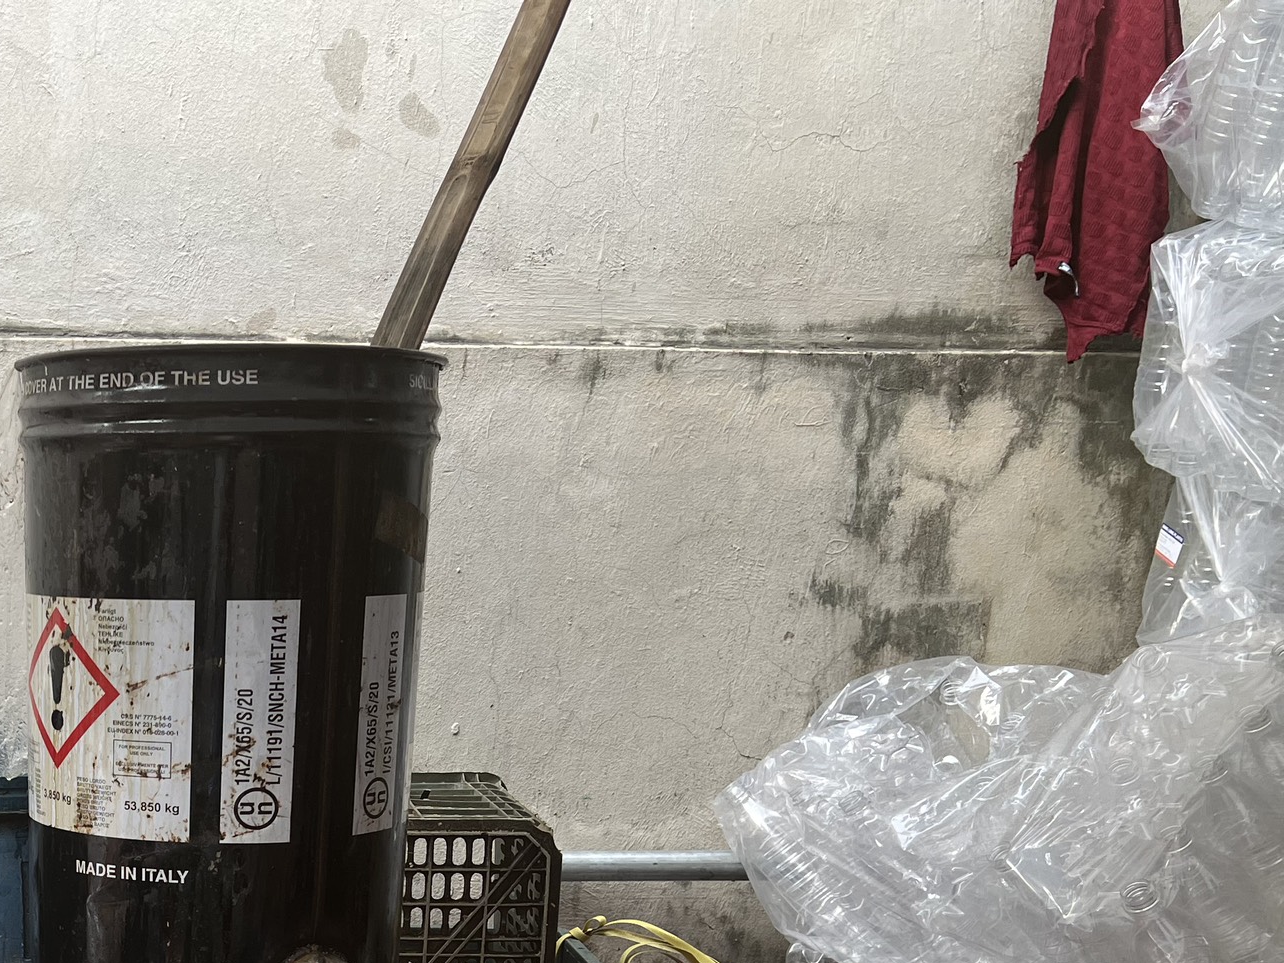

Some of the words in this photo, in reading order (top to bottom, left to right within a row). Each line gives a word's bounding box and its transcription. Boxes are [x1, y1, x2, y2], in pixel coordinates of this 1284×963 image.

[48, 376, 64, 392] AT
[67, 374, 95, 391] THE
[99, 372, 135, 388] END
[139, 371, 166, 387] OF
[170, 370, 211, 386] THE
[217, 369, 259, 386] USE
[266, 614, 288, 785] L/11191/SNCH-META14
[234, 688, 254, 786] 1A2/X65/S/20
[364, 681, 380, 777] 1A2/X65/S/20
[62, 792, 72, 806] kg
[124, 800, 161, 813] 53,850
[164, 802, 180, 816] kg
[75, 859, 117, 879] MADE
[120, 865, 137, 881] IN
[141, 867, 189, 884] ITALY
